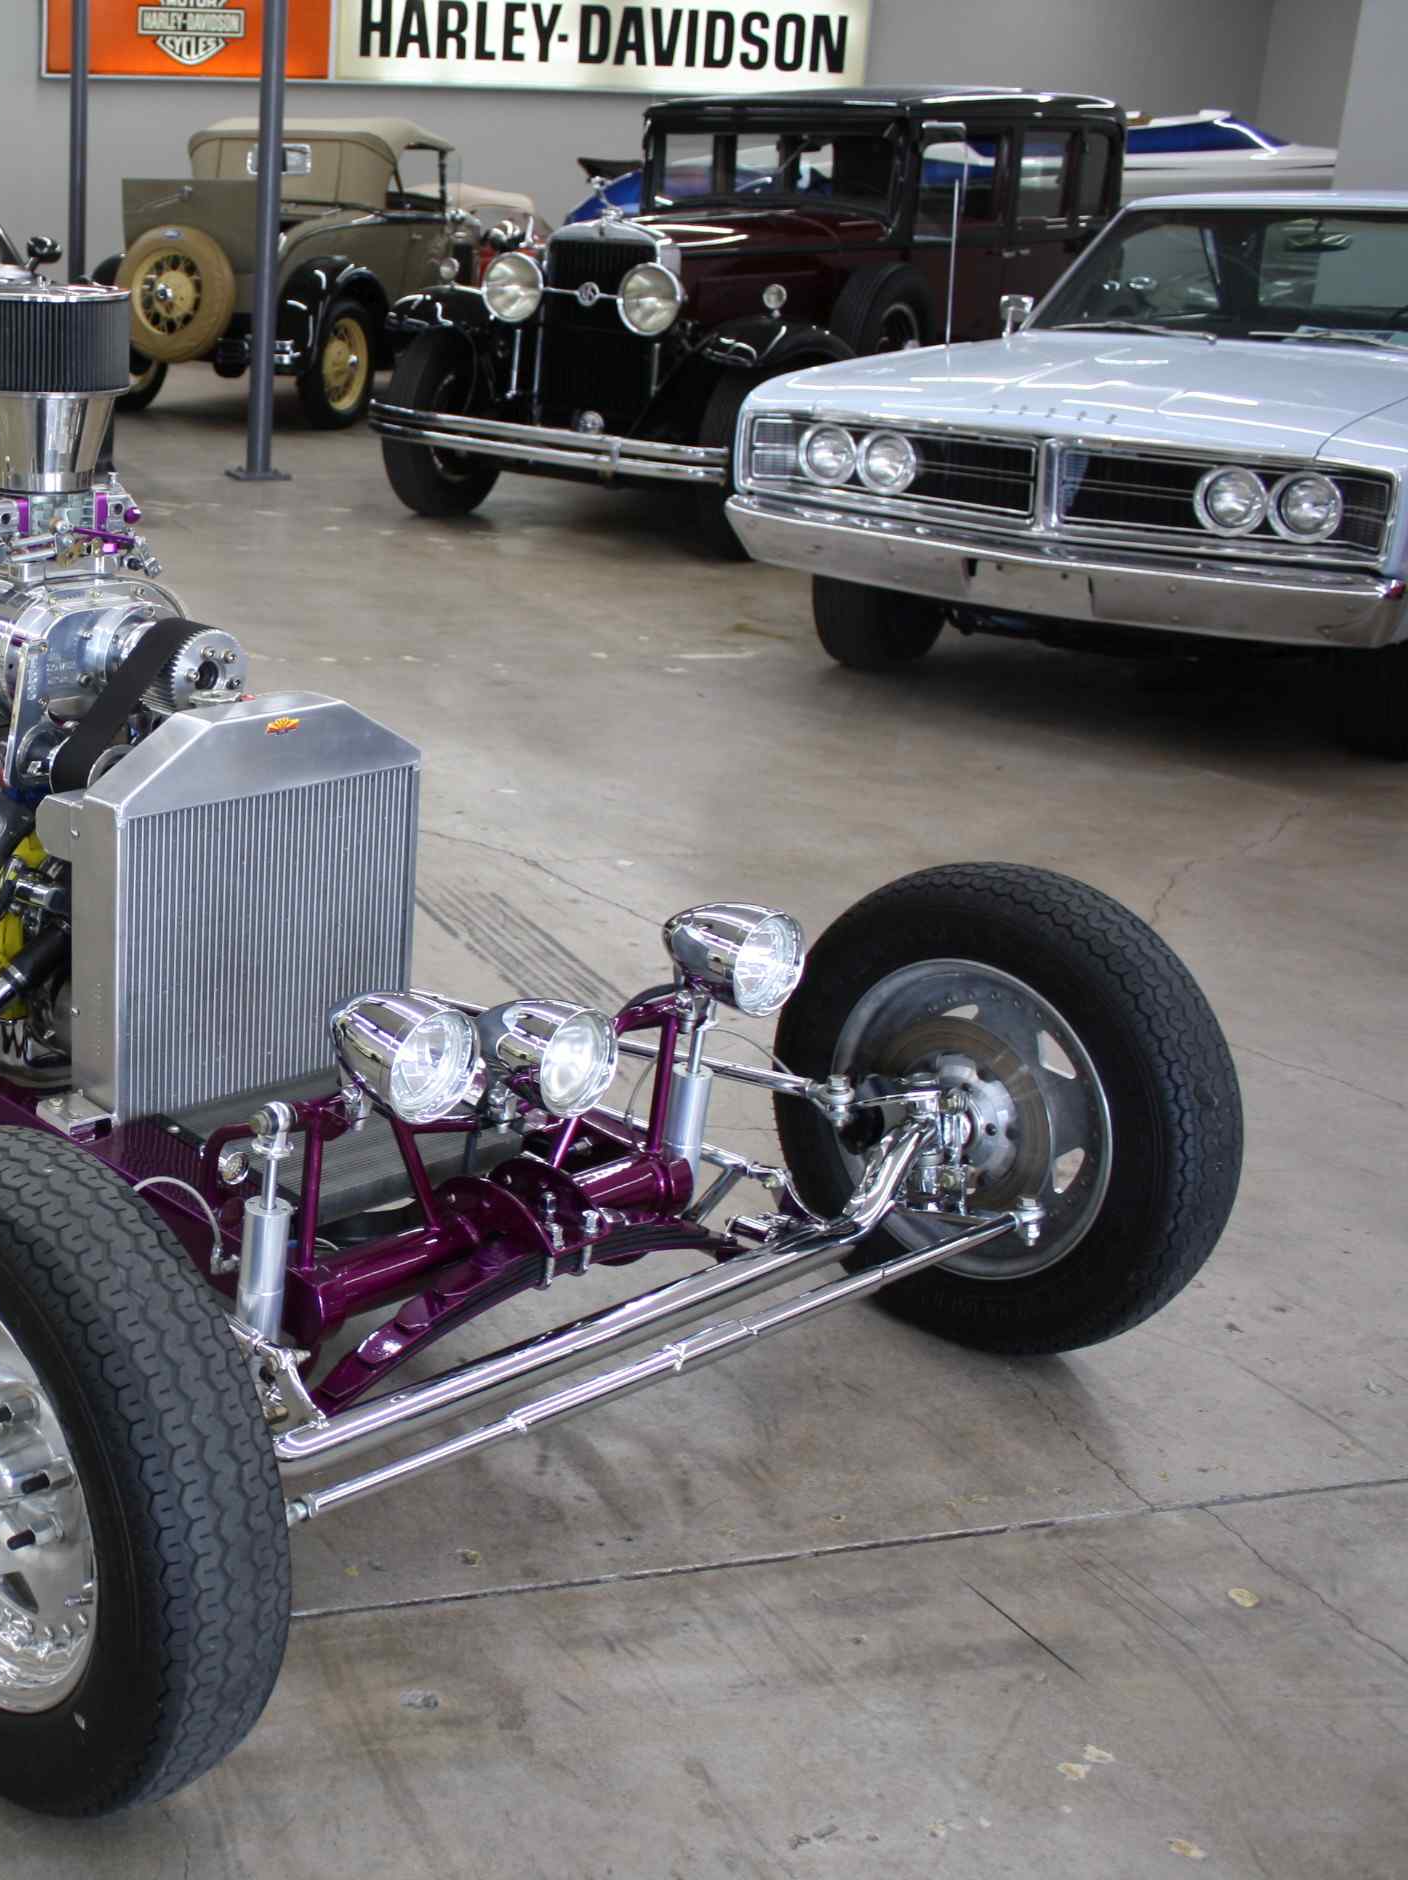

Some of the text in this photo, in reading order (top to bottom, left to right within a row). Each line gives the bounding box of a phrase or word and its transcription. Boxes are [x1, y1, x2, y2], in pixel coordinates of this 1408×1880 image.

[143, 11, 240, 32] HARLEY-DAVIDSON
[164, 35, 217, 60] CYCLES
[359, 0, 849, 74] HARLEY-DAVIDSON
